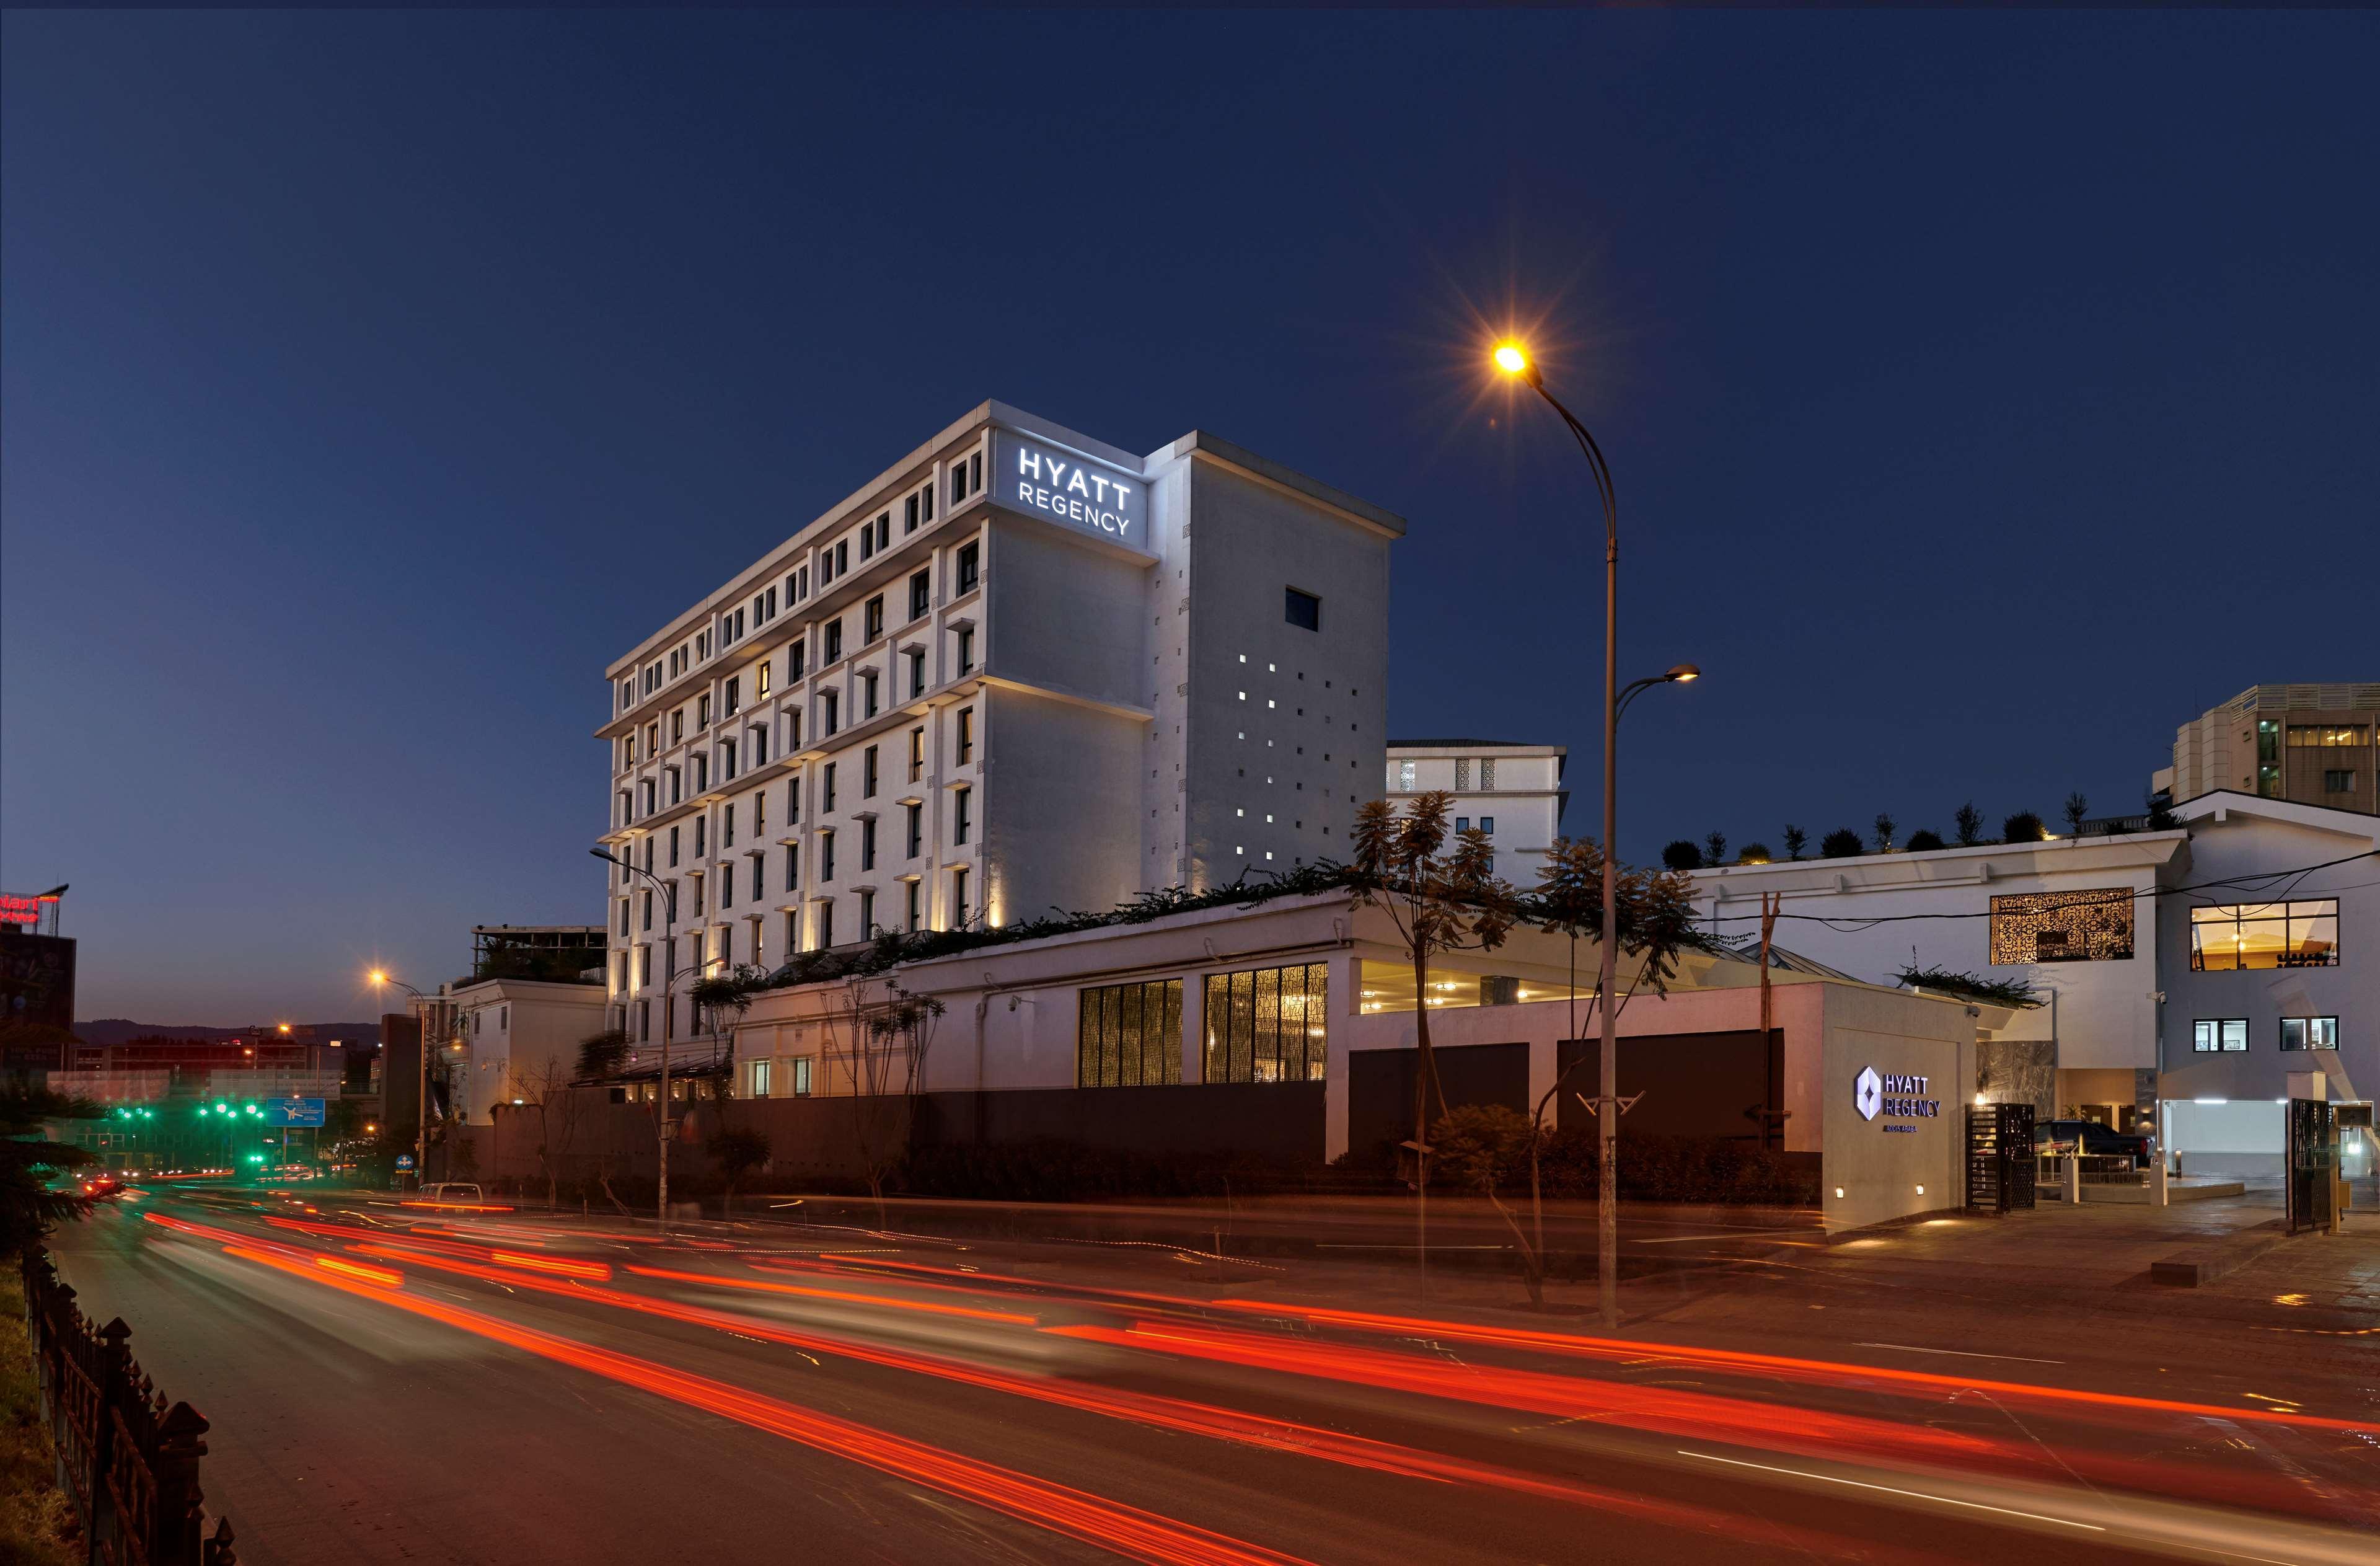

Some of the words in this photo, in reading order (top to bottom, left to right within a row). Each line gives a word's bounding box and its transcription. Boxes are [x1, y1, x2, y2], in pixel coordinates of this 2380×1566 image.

[1020, 448, 1130, 510] HYATT
[1019, 482, 1129, 536] REGENCY
[1886, 1074, 1928, 1094] HYATT
[1886, 1099, 1941, 1117] REGENCY
